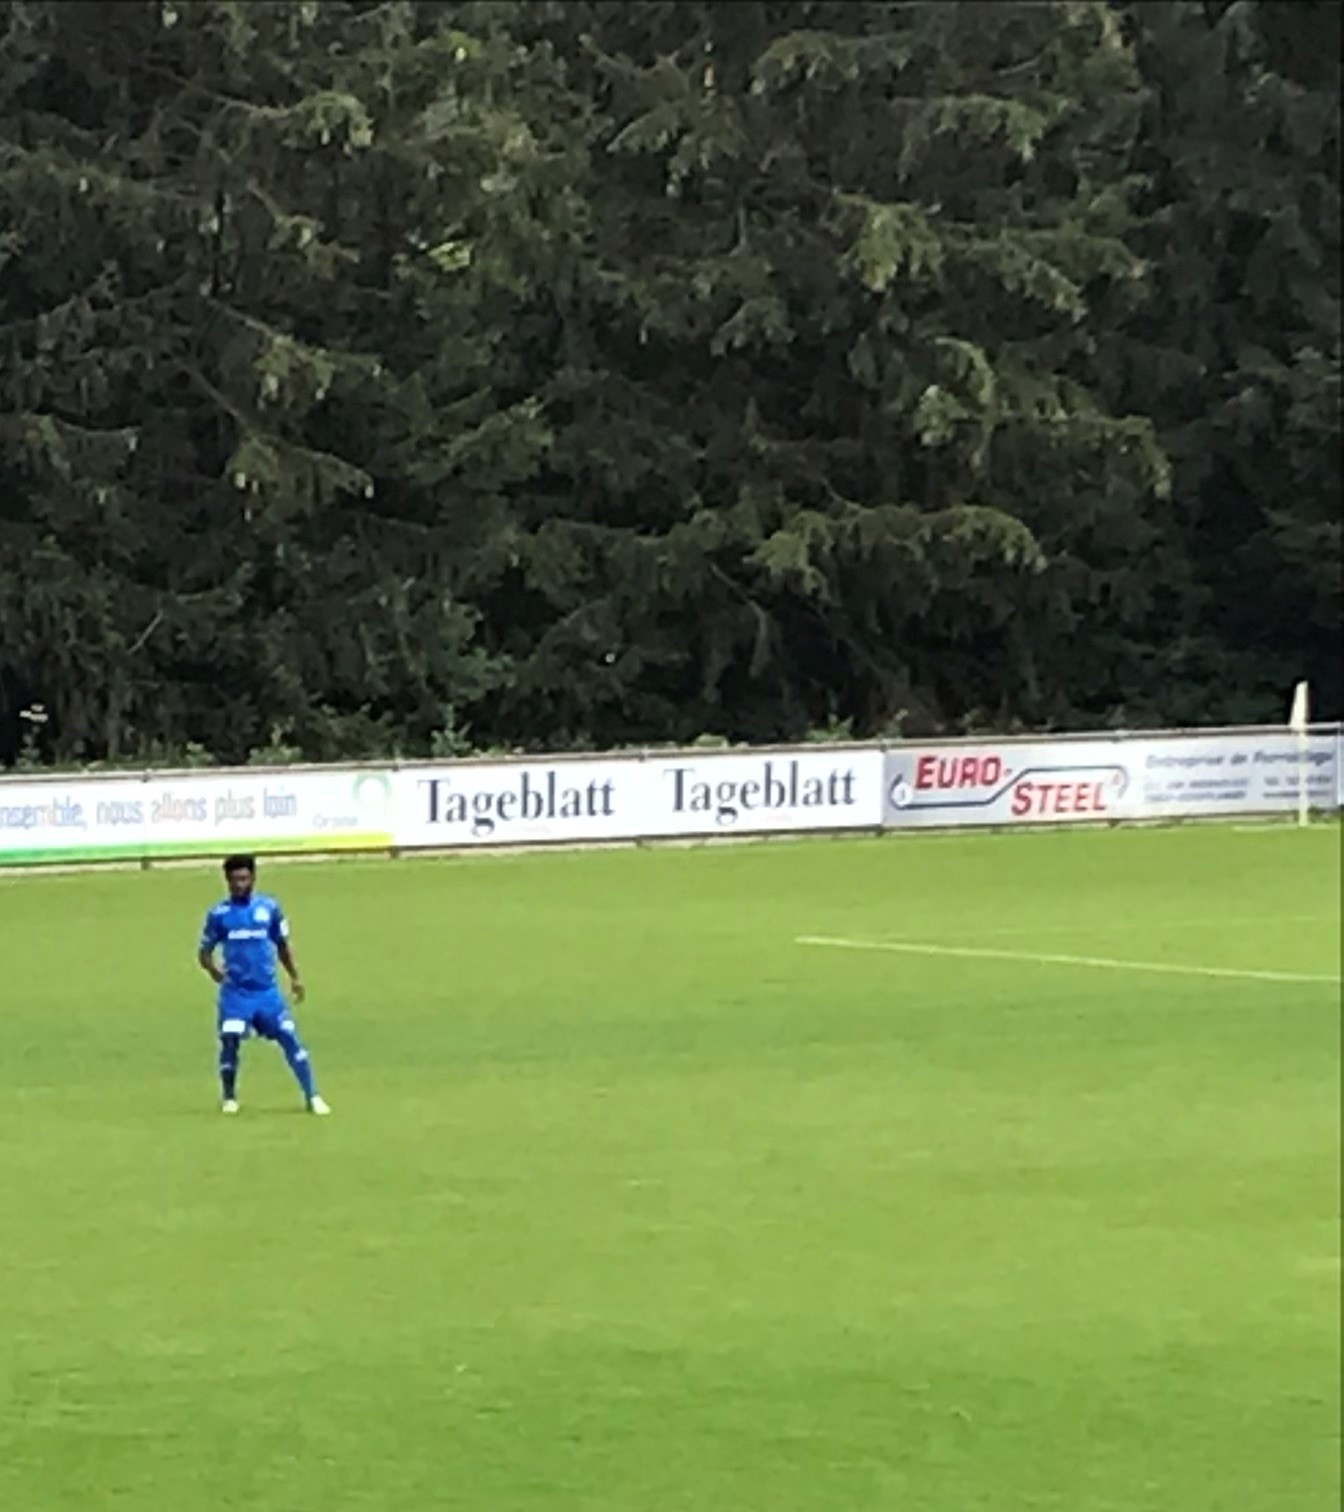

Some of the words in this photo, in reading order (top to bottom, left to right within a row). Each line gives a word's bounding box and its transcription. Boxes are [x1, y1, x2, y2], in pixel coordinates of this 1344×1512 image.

[96, 800, 144, 825] nous
[151, 790, 208, 823] allons
[214, 789, 256, 827] plus
[263, 786, 297, 818] loin
[418, 770, 616, 837] Tageblatt
[663, 760, 857, 826] Tageblatt
[1012, 782, 1107, 815] STEEL
